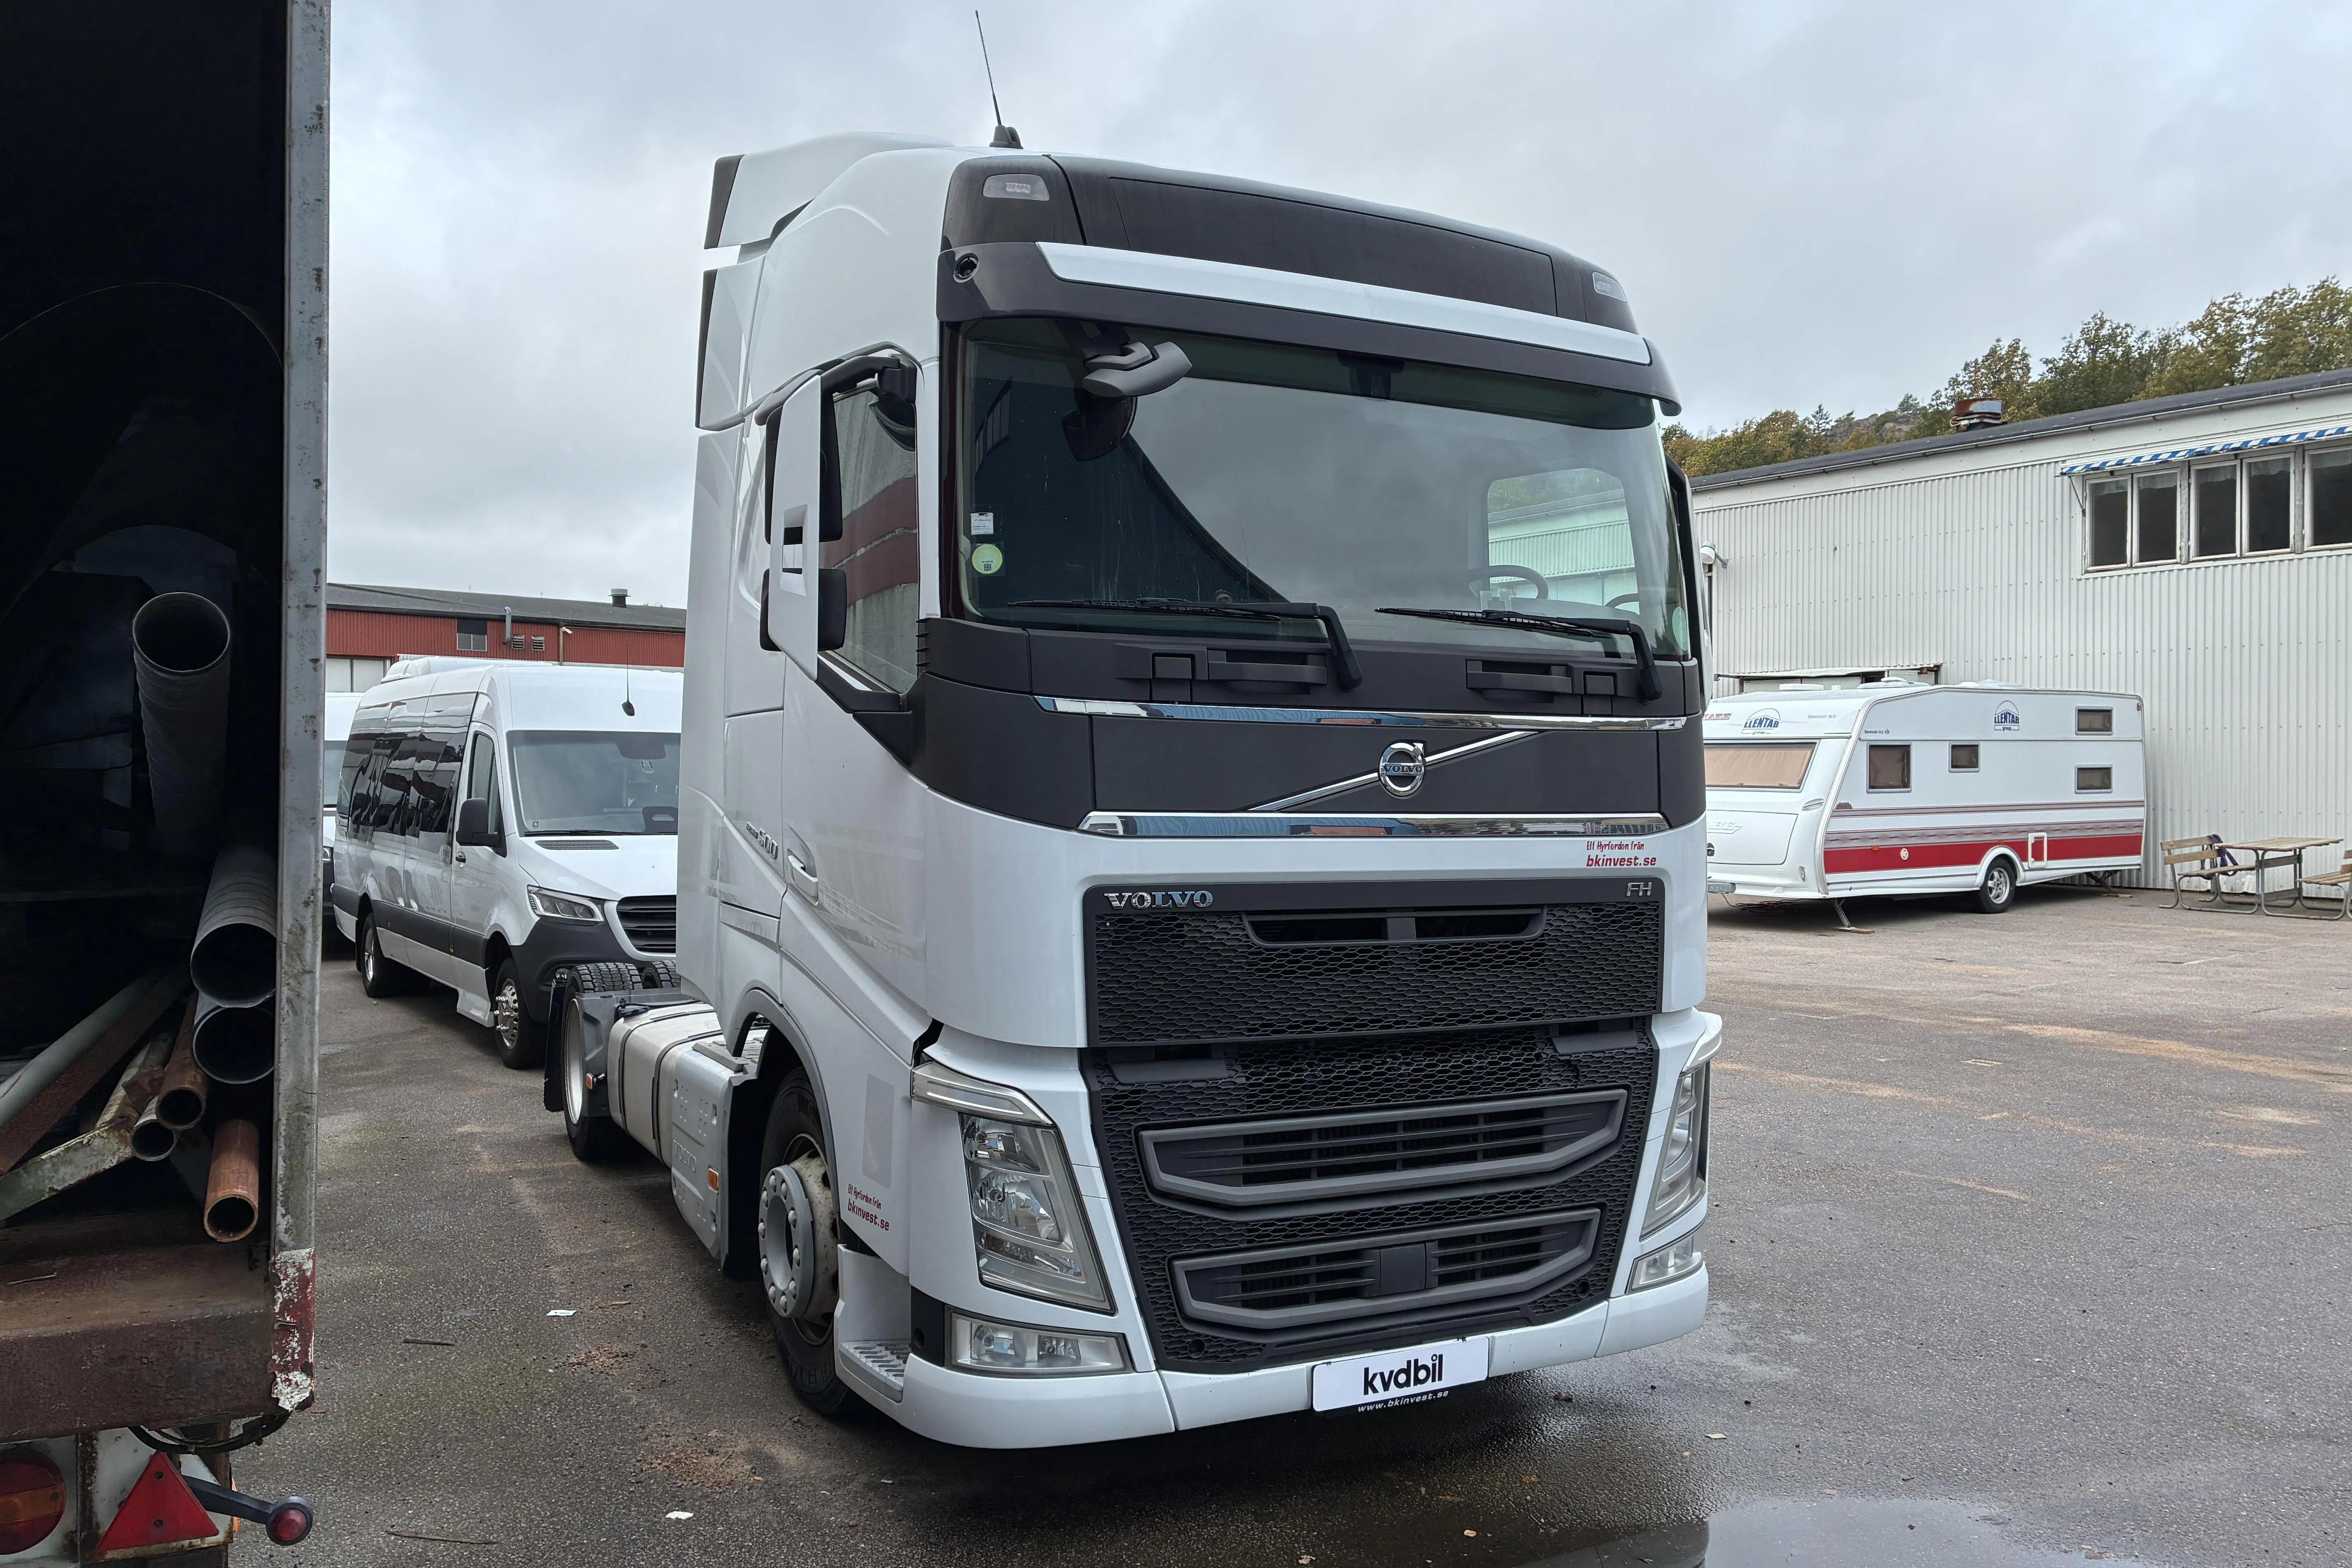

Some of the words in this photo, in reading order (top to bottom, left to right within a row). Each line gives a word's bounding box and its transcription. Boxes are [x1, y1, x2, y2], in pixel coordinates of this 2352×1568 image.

[1743, 717, 1779, 728] LLENTAB
[1994, 711, 2019, 724] LLENTAB
[1381, 764, 1423, 773] VOLVO
[758, 827, 778, 860] 500
[1597, 841, 1629, 852] Hyrfordon
[1631, 841, 1644, 850] från
[1586, 854, 1657, 867] bkinvest.se
[1626, 882, 1652, 896] FH
[1104, 891, 1213, 909] VOLVO
[848, 1198, 889, 1231] bkinvest.se
[1363, 1353, 1443, 1396] kvdbil
[1358, 1391, 1449, 1412] www.bkinvest.se
